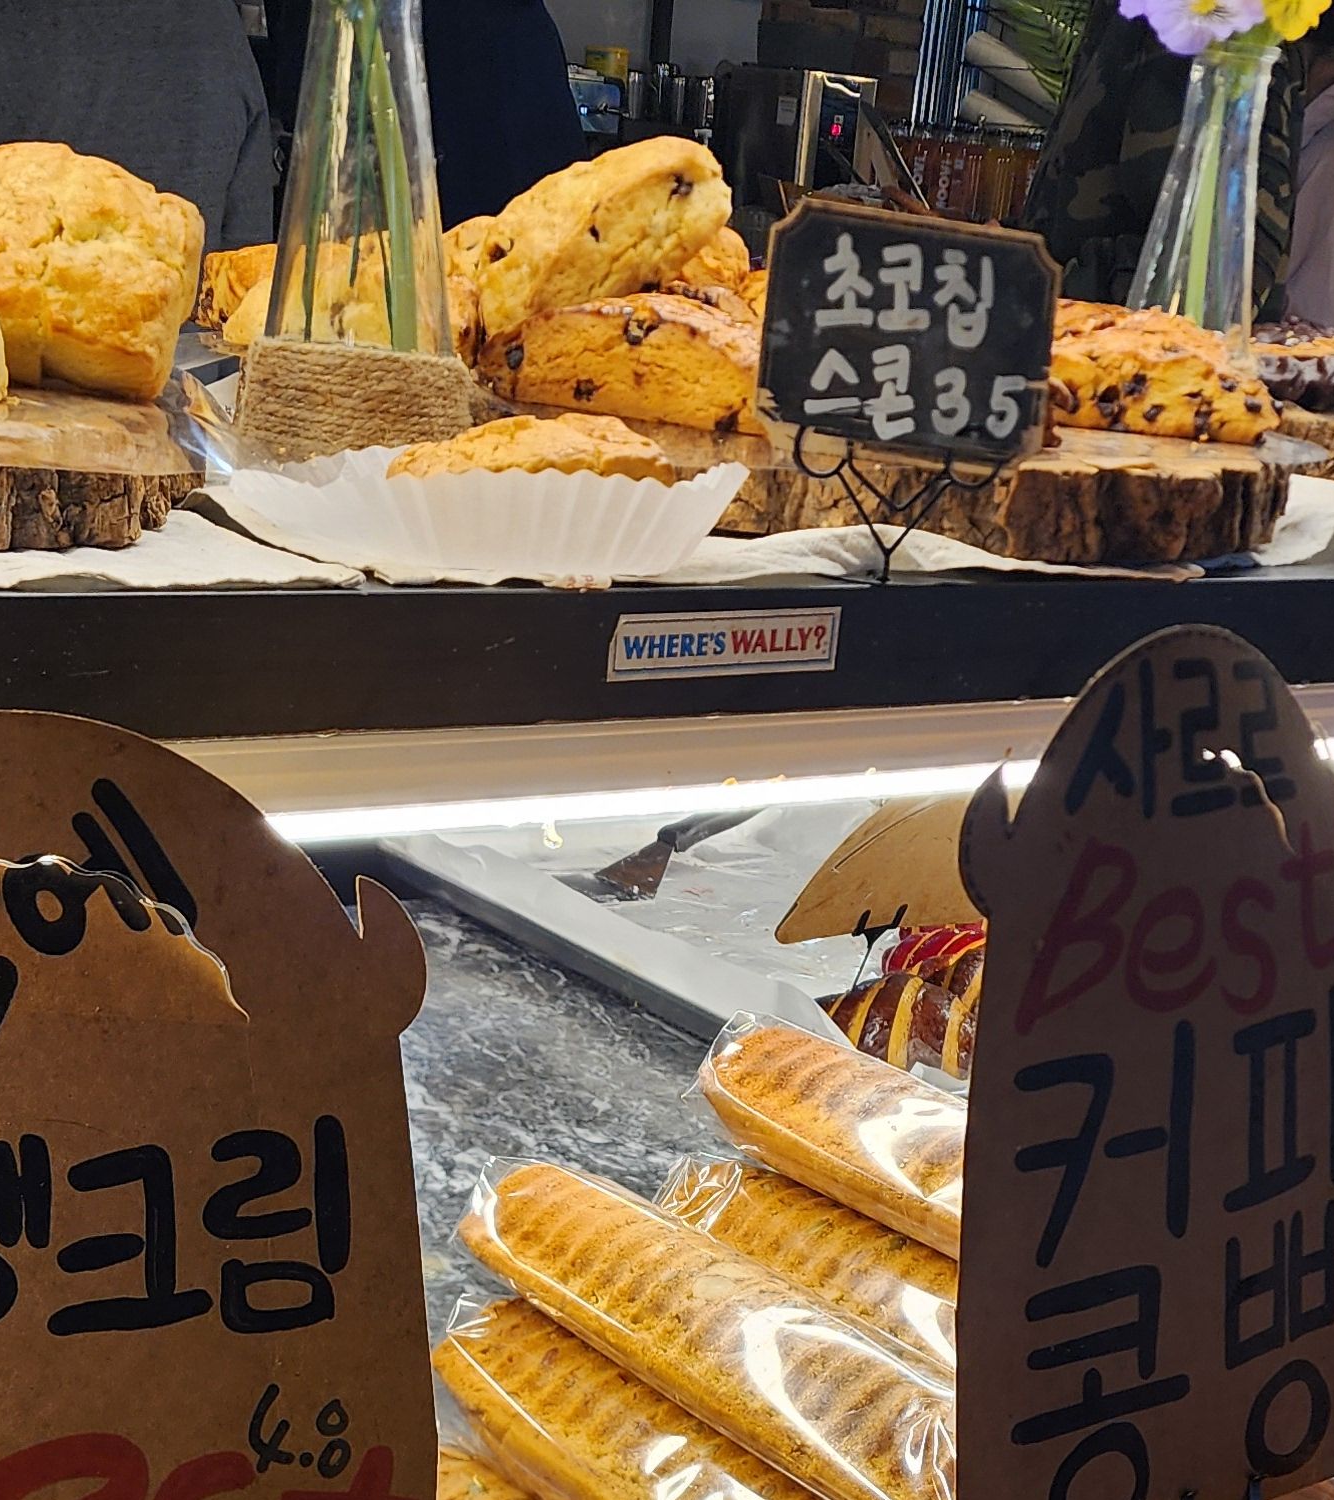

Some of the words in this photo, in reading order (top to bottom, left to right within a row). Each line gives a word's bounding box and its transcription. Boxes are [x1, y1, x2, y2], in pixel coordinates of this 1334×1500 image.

[815, 233, 994, 348] 초코칩
[803, 344, 915, 441] 스콘
[623, 631, 727, 660] WHERE'S
[731, 625, 827, 655] WALLY?
[1064, 657, 1297, 819] 사르르
[248, 1383, 352, 1480] 4.8
